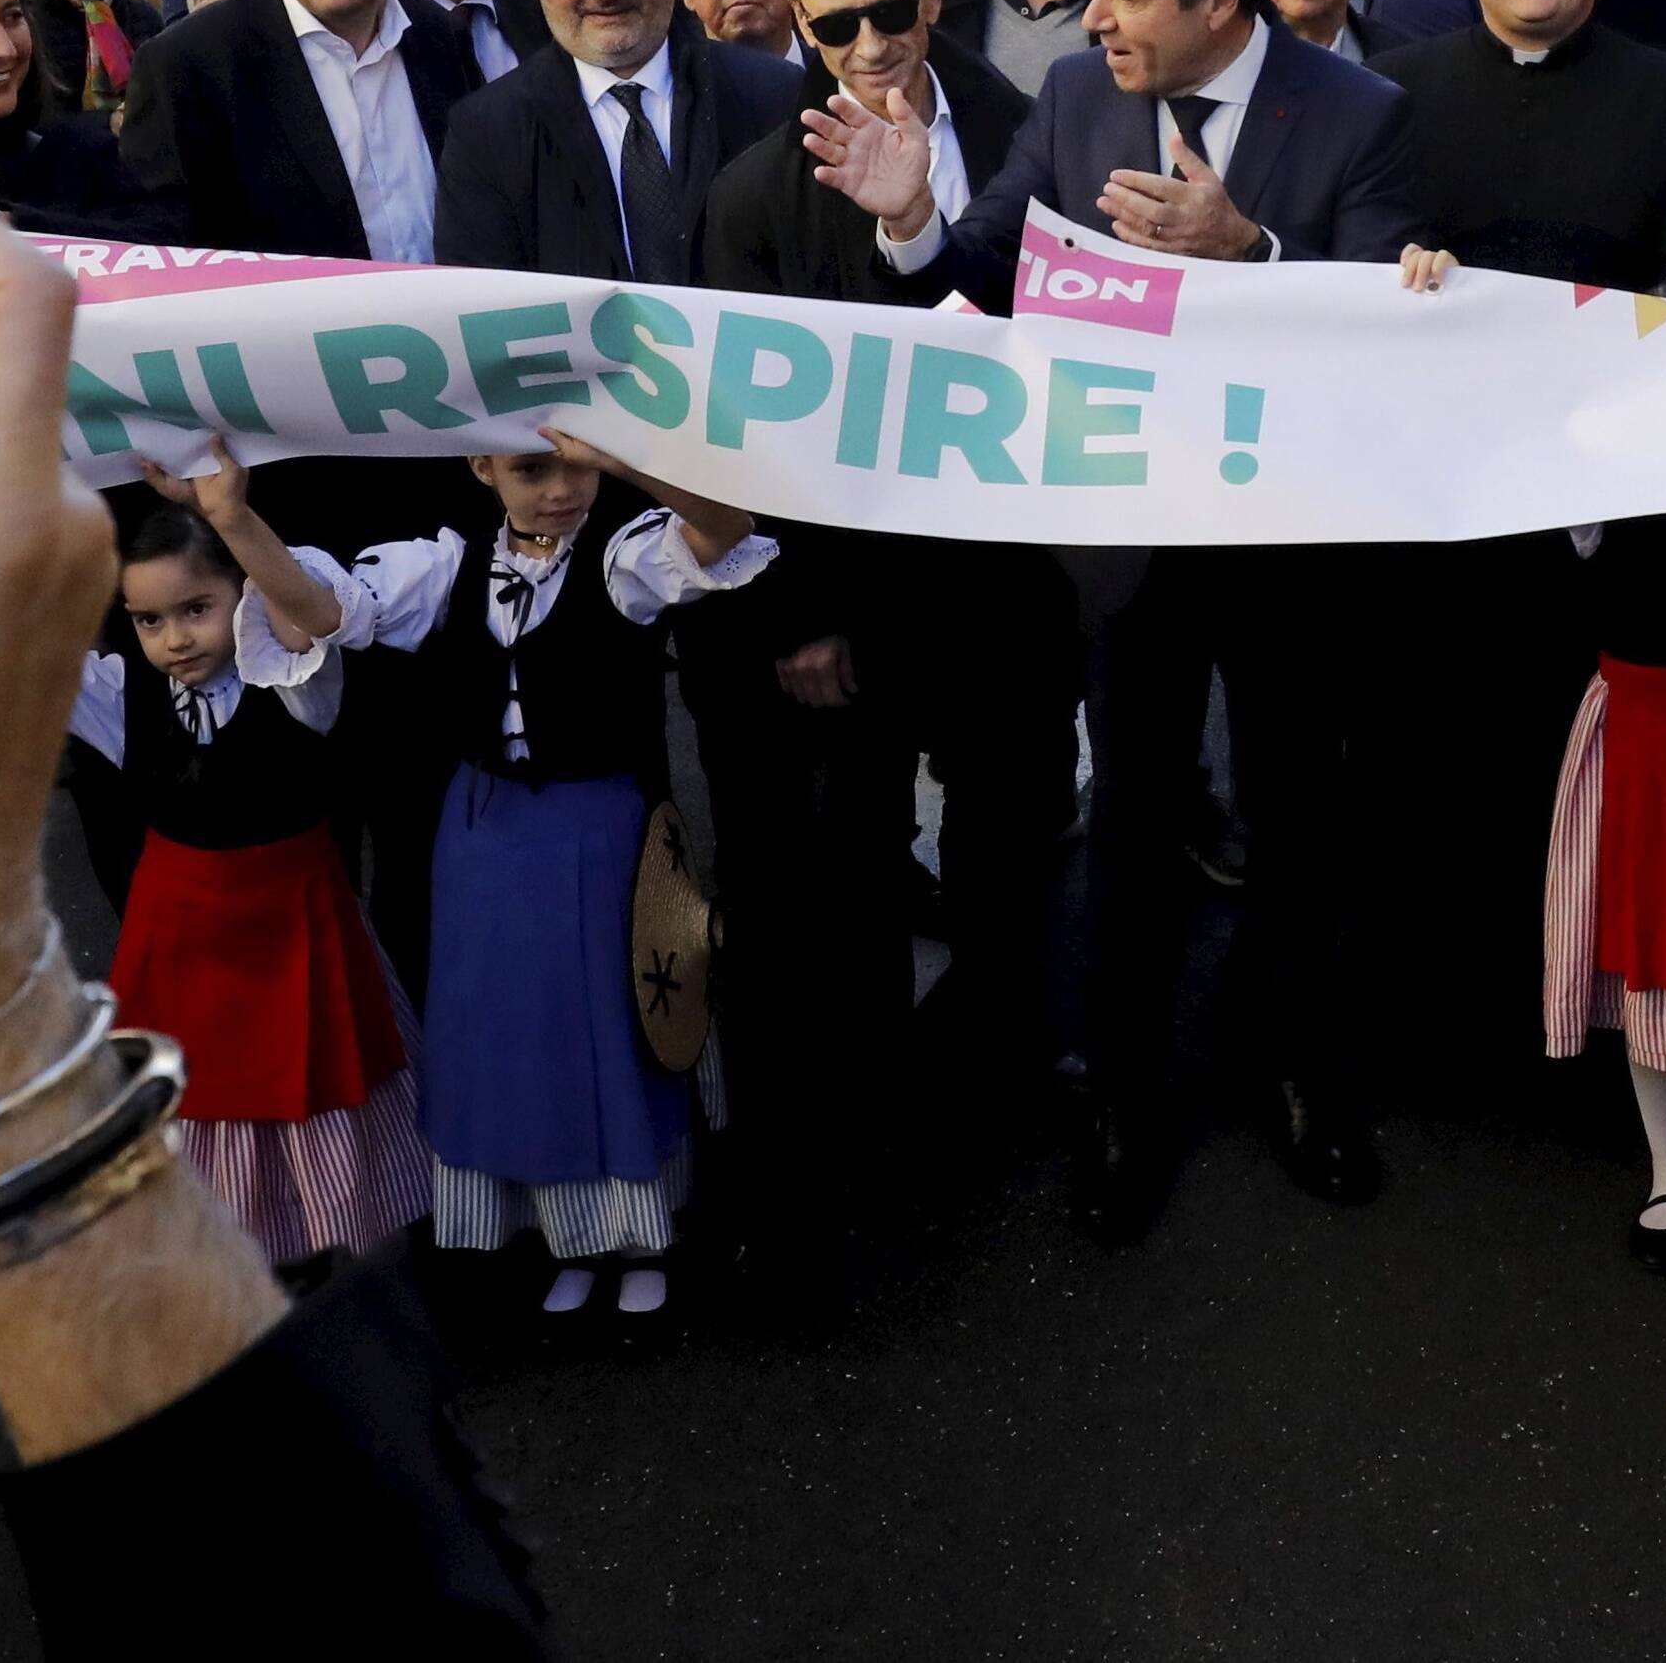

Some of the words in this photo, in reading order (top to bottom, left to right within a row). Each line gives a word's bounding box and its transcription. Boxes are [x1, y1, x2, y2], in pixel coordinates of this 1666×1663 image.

[66, 341, 277, 461] NI
[312, 291, 1156, 487] RESPIRE
[1218, 383, 1265, 485] !
